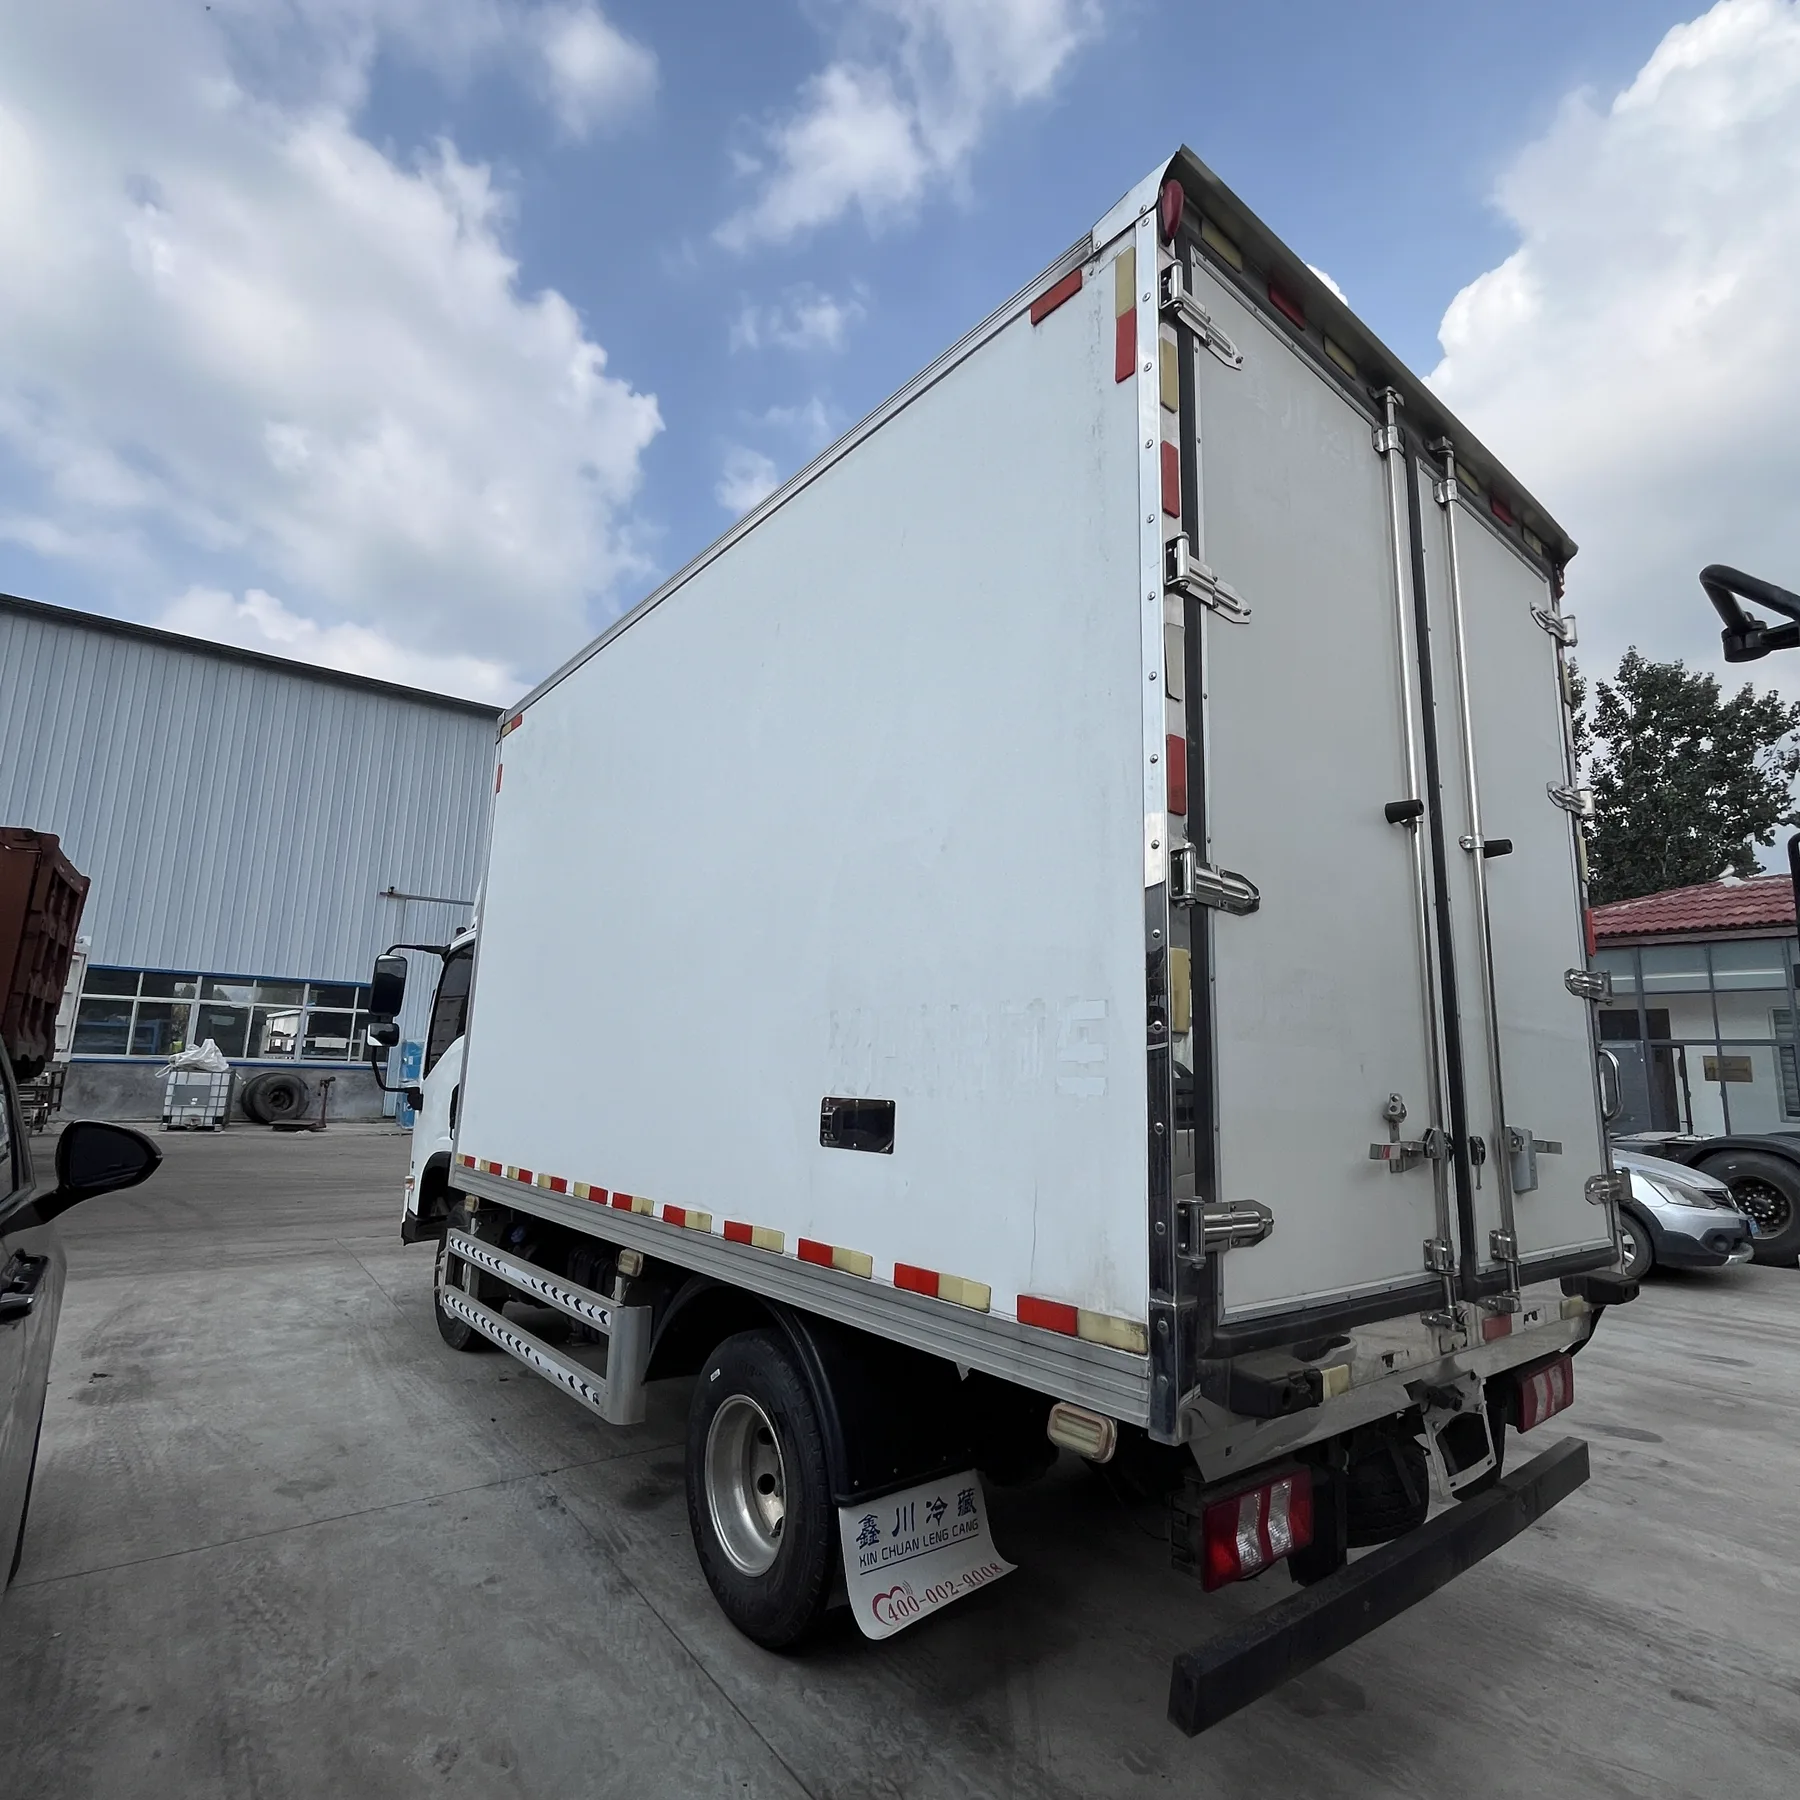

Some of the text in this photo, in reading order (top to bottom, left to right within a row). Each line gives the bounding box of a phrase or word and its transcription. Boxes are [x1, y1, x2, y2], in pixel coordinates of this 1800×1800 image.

[856, 1487, 977, 1550] 鑫川冷藏
[859, 1518, 979, 1568] XIN CHUAN LENG CANG
[888, 1563, 1003, 1621] 400-002-9008
